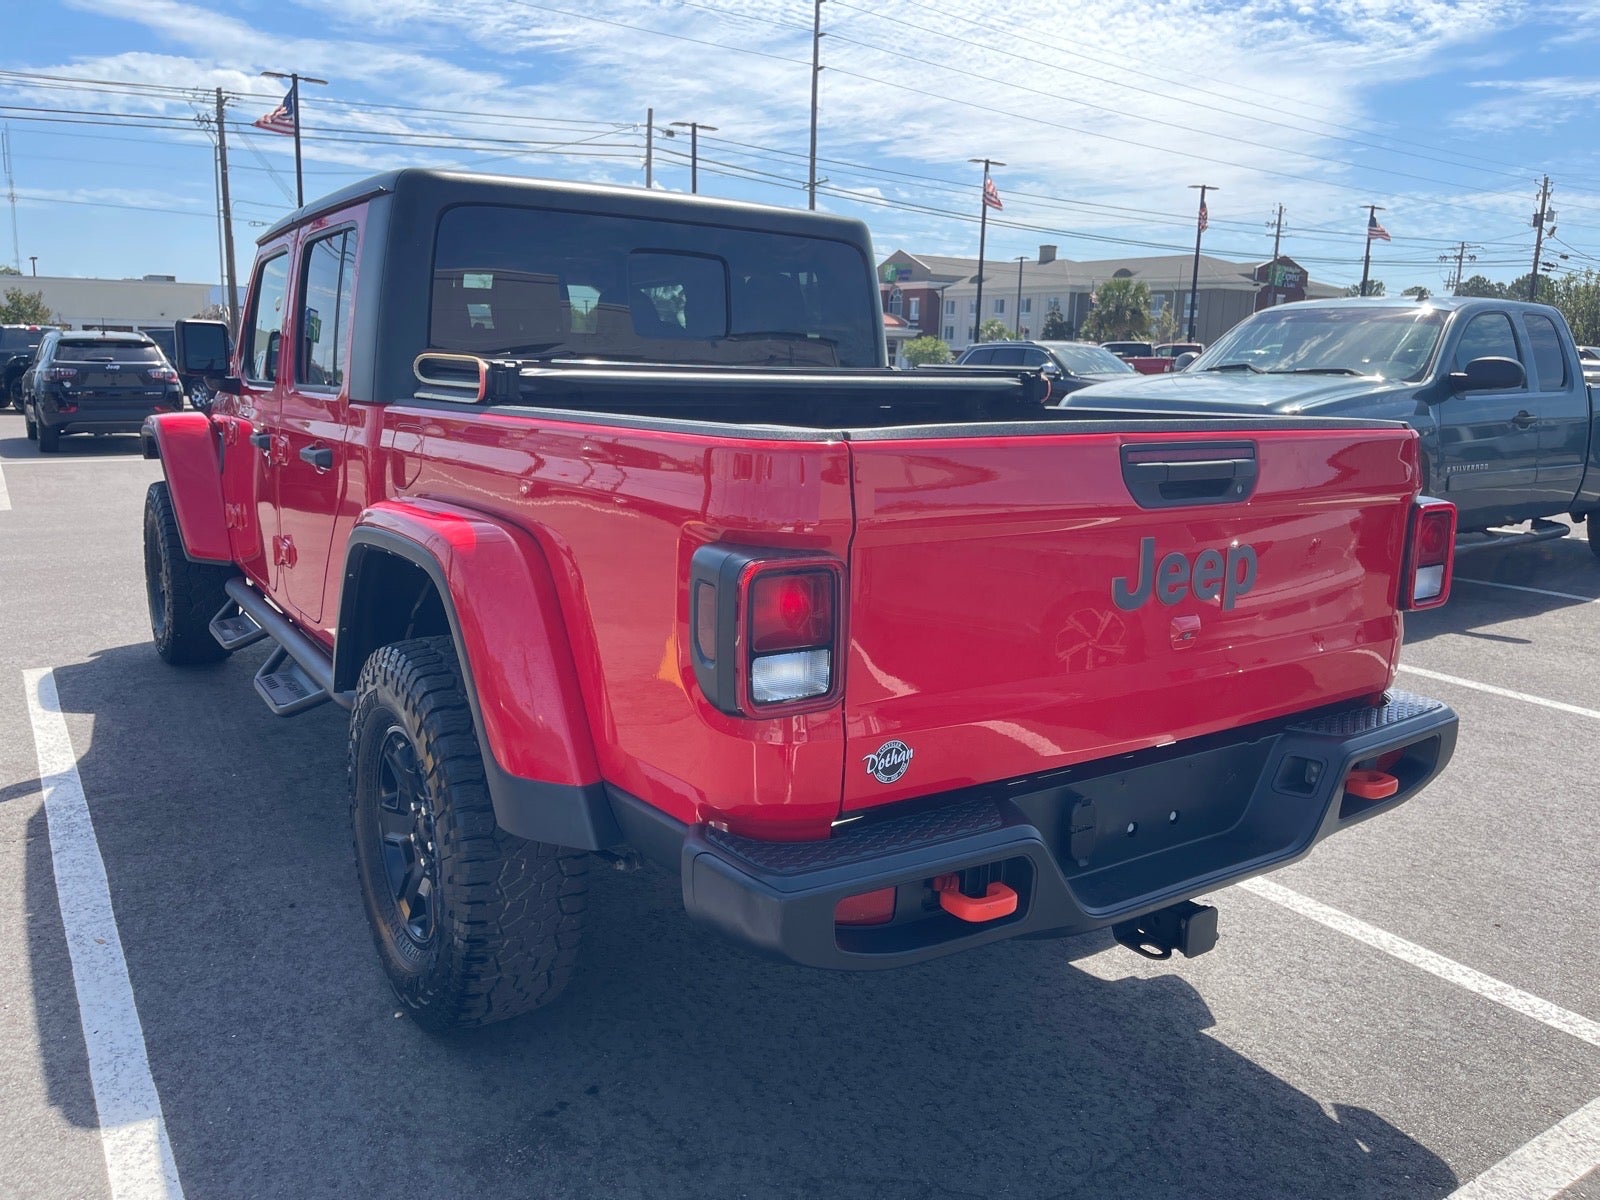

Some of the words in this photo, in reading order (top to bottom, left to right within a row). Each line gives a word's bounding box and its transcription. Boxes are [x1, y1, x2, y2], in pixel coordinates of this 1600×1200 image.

[1452, 463, 1489, 472] SILVERADO
[1111, 536, 1258, 612] Jeep
[862, 748, 914, 774] Dothan
